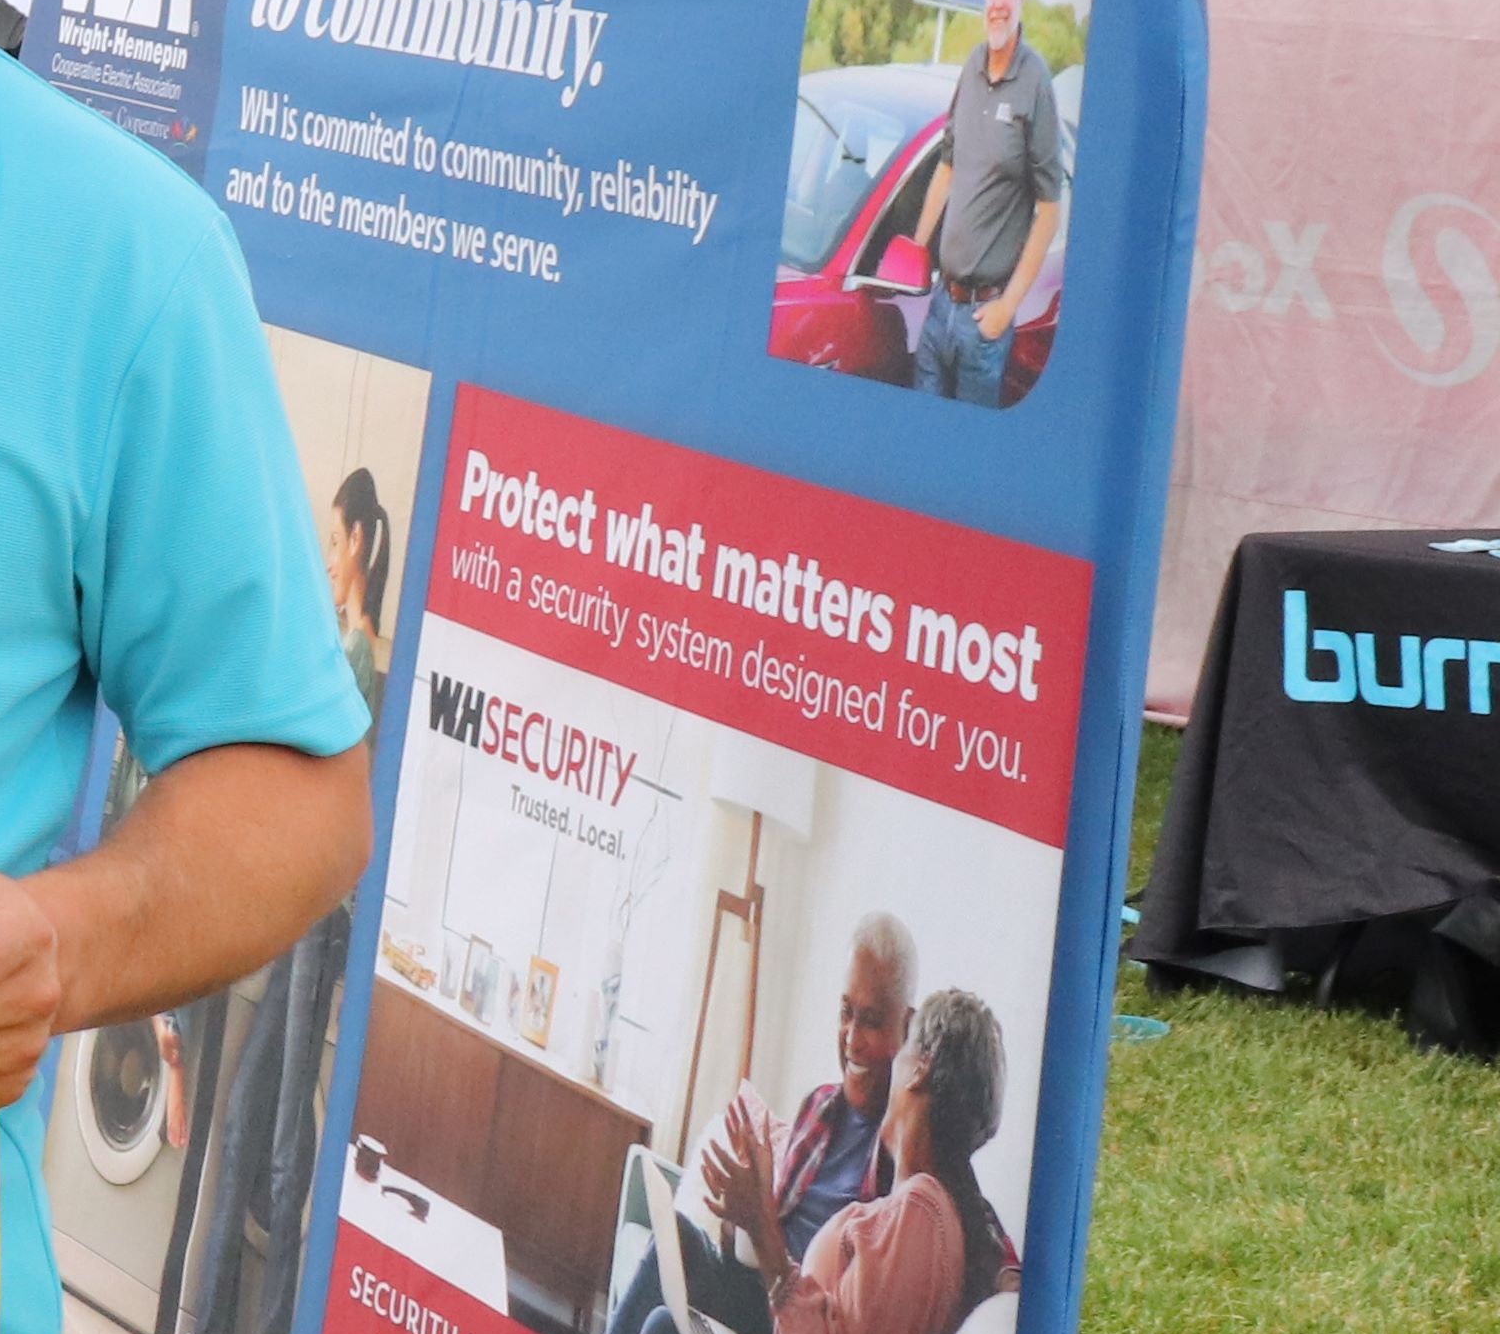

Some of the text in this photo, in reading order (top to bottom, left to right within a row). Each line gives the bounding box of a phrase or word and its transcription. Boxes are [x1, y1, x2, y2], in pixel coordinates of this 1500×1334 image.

[51, 52, 182, 100] Cooperative Electric Association
[58, 15, 188, 70] Wright-Hennepin
[226, 162, 561, 283] and to the members we serve.
[240, 86, 718, 245] WH is commited to community, reliability
[459, 448, 1043, 702] Protect what matters most
[451, 542, 1029, 784] with a security system designed for you.
[429, 672, 637, 807] WHSECURITY
[509, 783, 626, 861] Trusted. Local.
